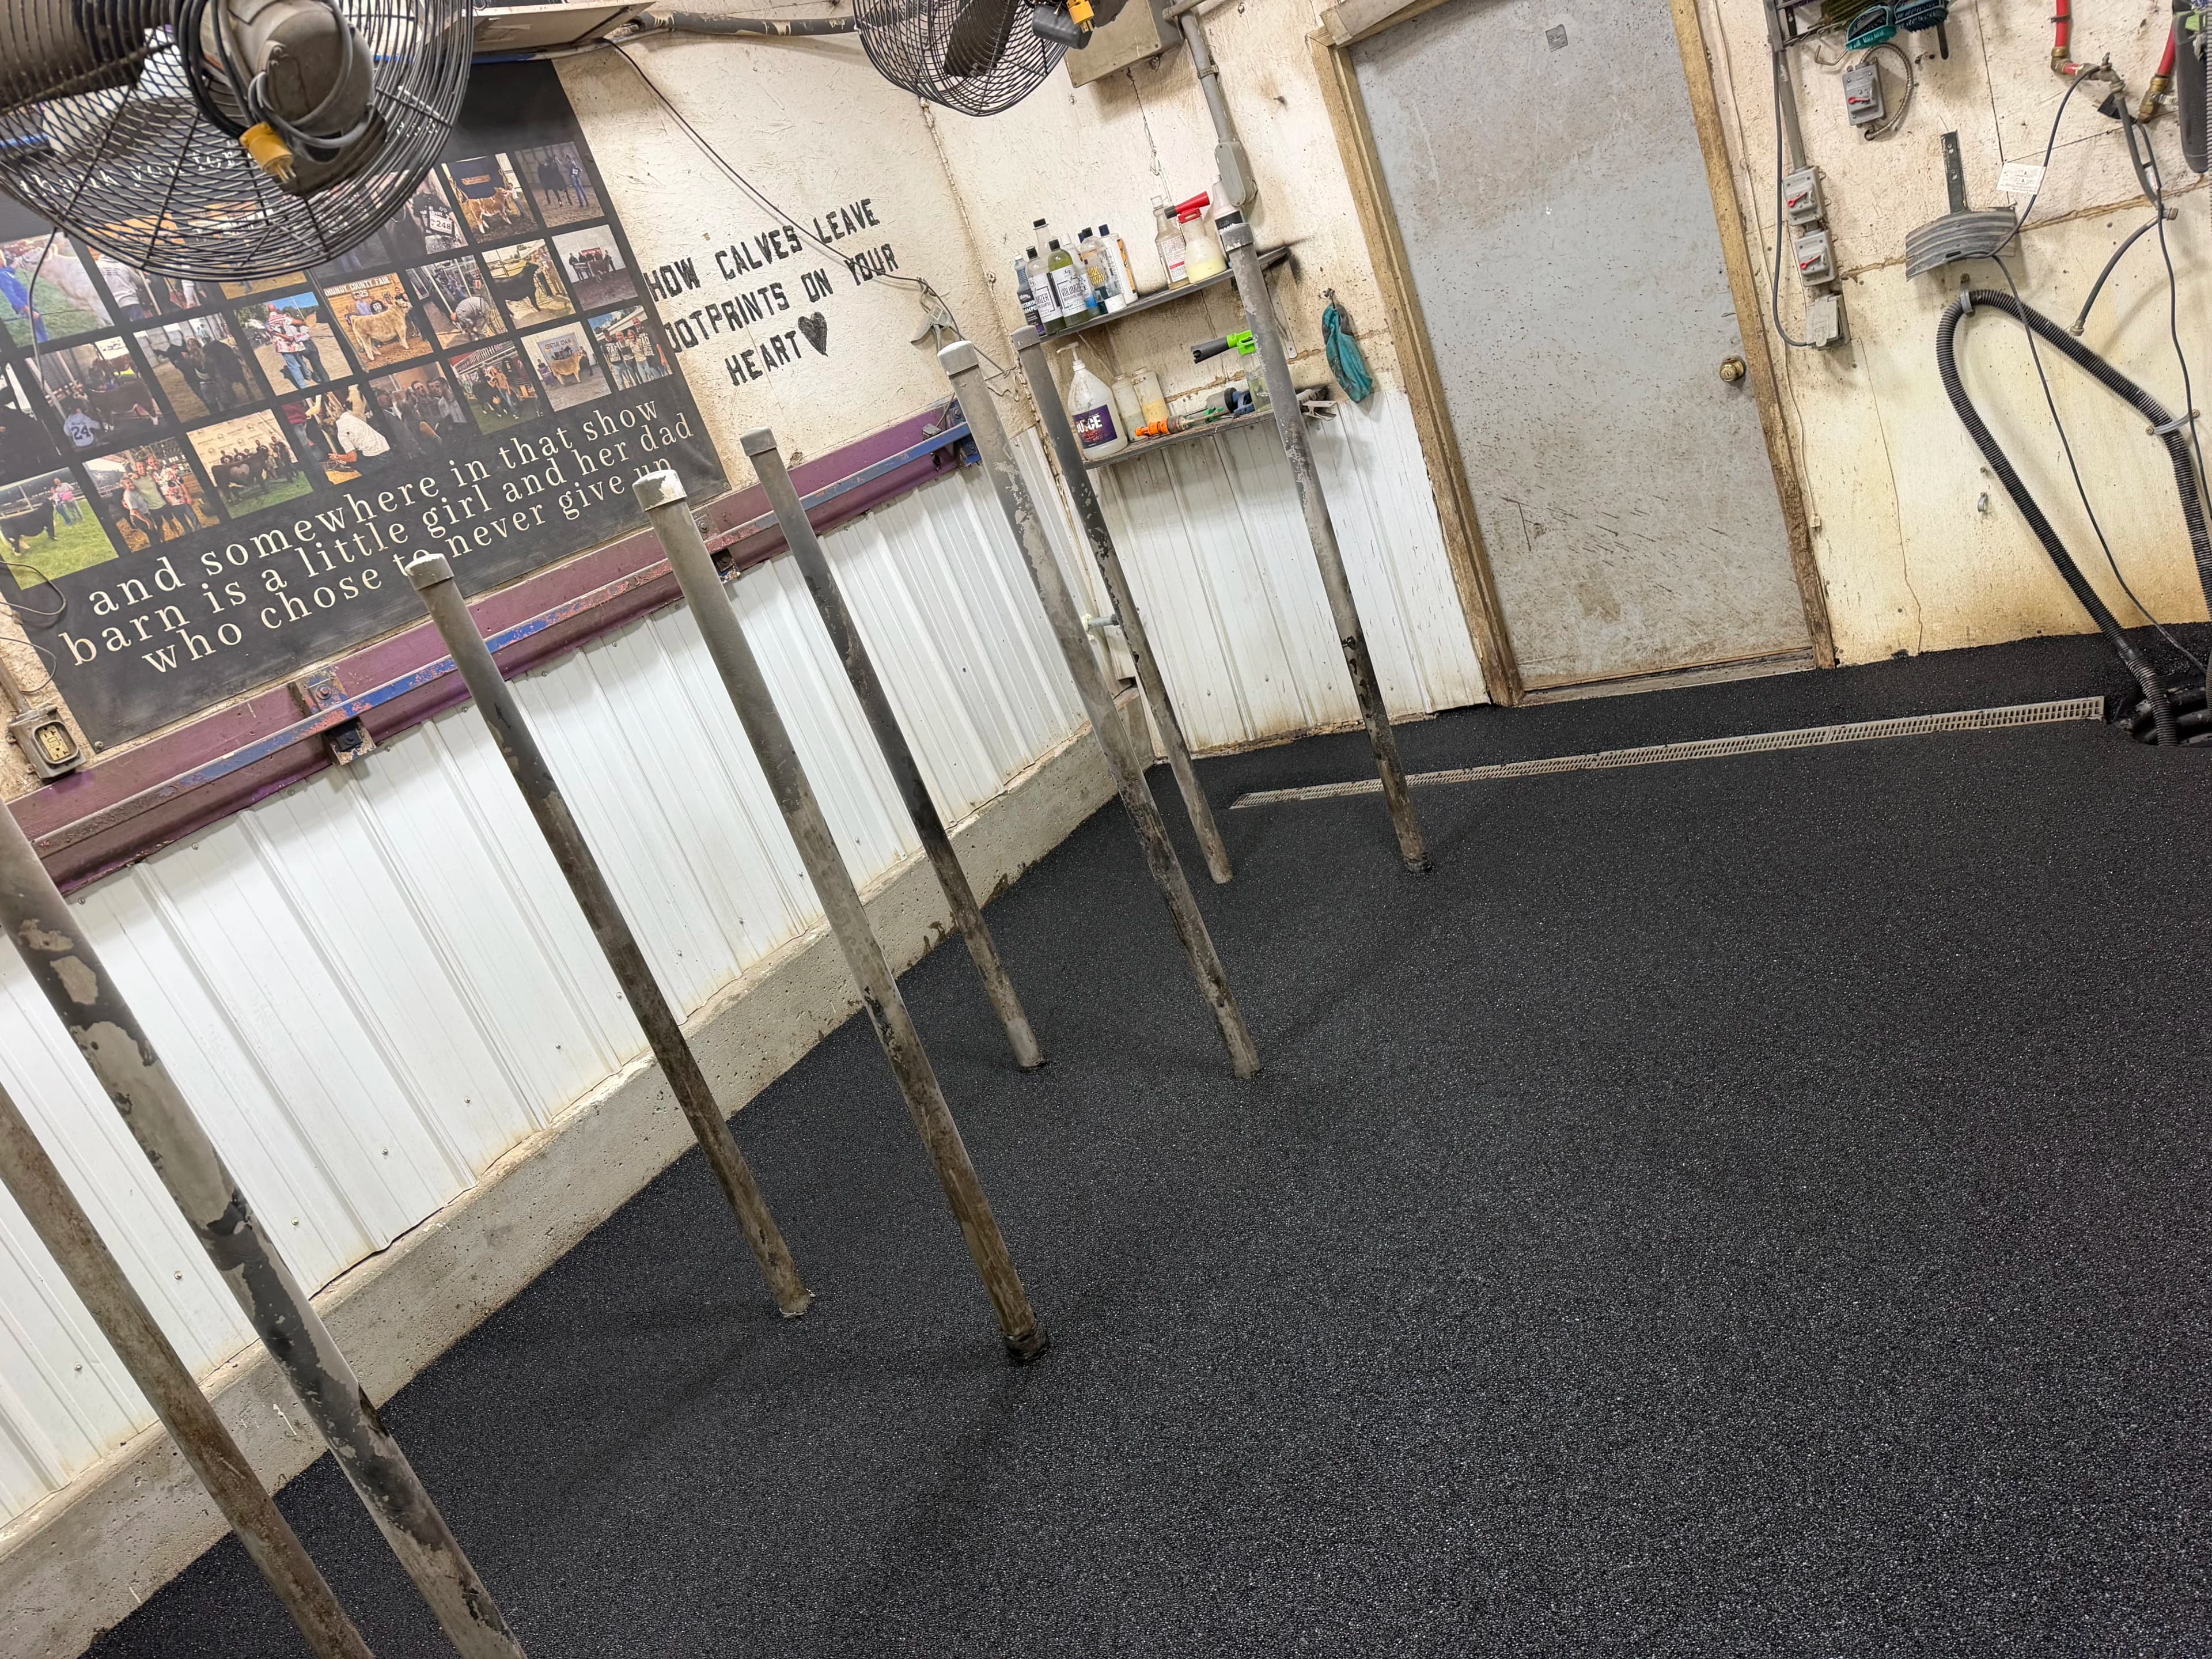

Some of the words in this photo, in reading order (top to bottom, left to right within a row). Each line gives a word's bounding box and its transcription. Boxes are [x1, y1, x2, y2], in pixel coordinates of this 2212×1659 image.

[715, 225, 804, 281] CALVES
[813, 198, 881, 244] LEAVE
[801, 268, 834, 302] ON
[843, 243, 899, 286] YOUR
[349, 280, 373, 290] COUNTY
[374, 276, 390, 286] FAIR
[725, 329, 803, 387] HEART
[71, 425, 91, 440] 24
[59, 603, 190, 666] barn
[201, 580, 247, 613] is
[262, 569, 288, 592] a
[295, 520, 408, 577] little
[422, 484, 493, 539] girl
[502, 457, 567, 503] and
[571, 440, 630, 476] her
[640, 412, 694, 452] dad
[88, 556, 185, 616] and
[200, 476, 440, 575] somewhere
[449, 459, 491, 487] in
[499, 426, 573, 469] that
[583, 399, 658, 441] show
[142, 620, 243, 673] who
[260, 567, 382, 630] chose
[444, 503, 546, 558] never
[558, 474, 626, 520] give
